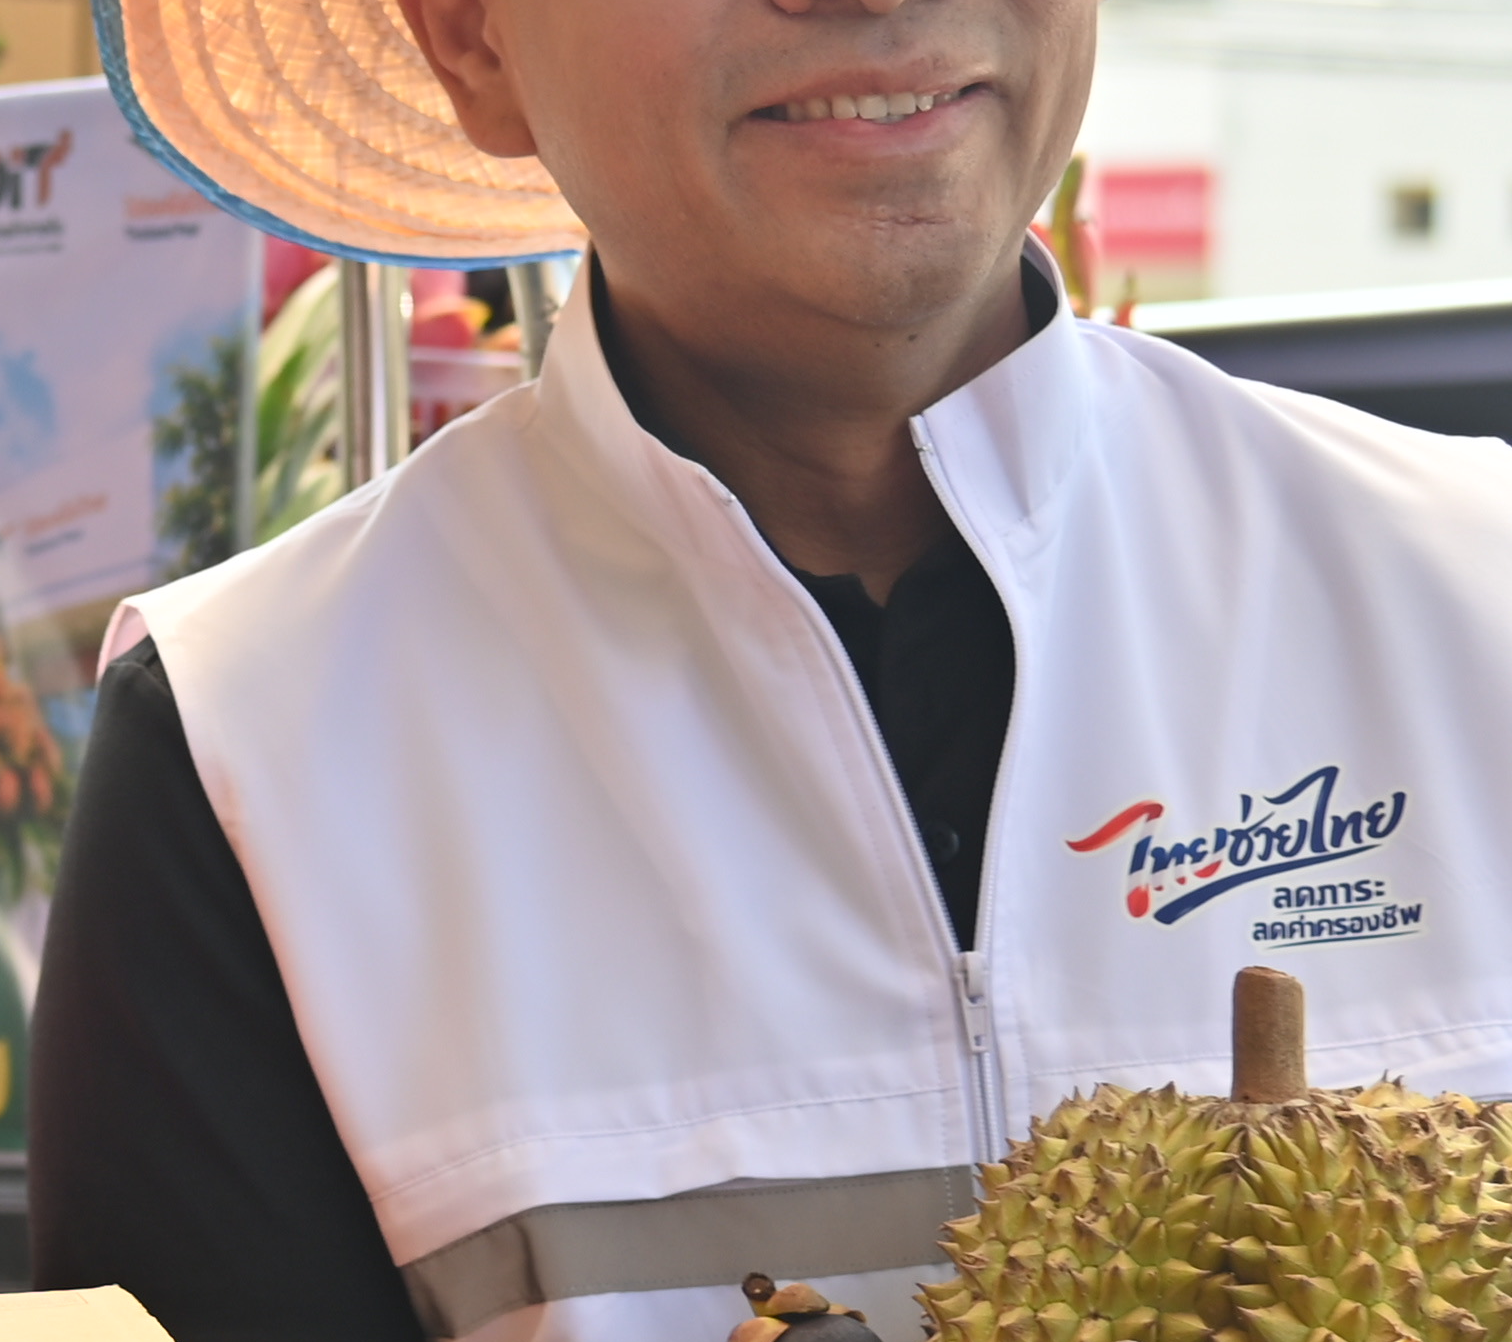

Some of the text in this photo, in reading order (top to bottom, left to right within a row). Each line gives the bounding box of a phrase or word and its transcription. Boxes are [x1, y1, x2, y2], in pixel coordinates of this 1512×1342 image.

[1065, 765, 1406, 918] ไทยช่วยไทย
[1272, 878, 1386, 910] ลดภาระ
[1251, 902, 1424, 943] ลดค่าครองชีพ
